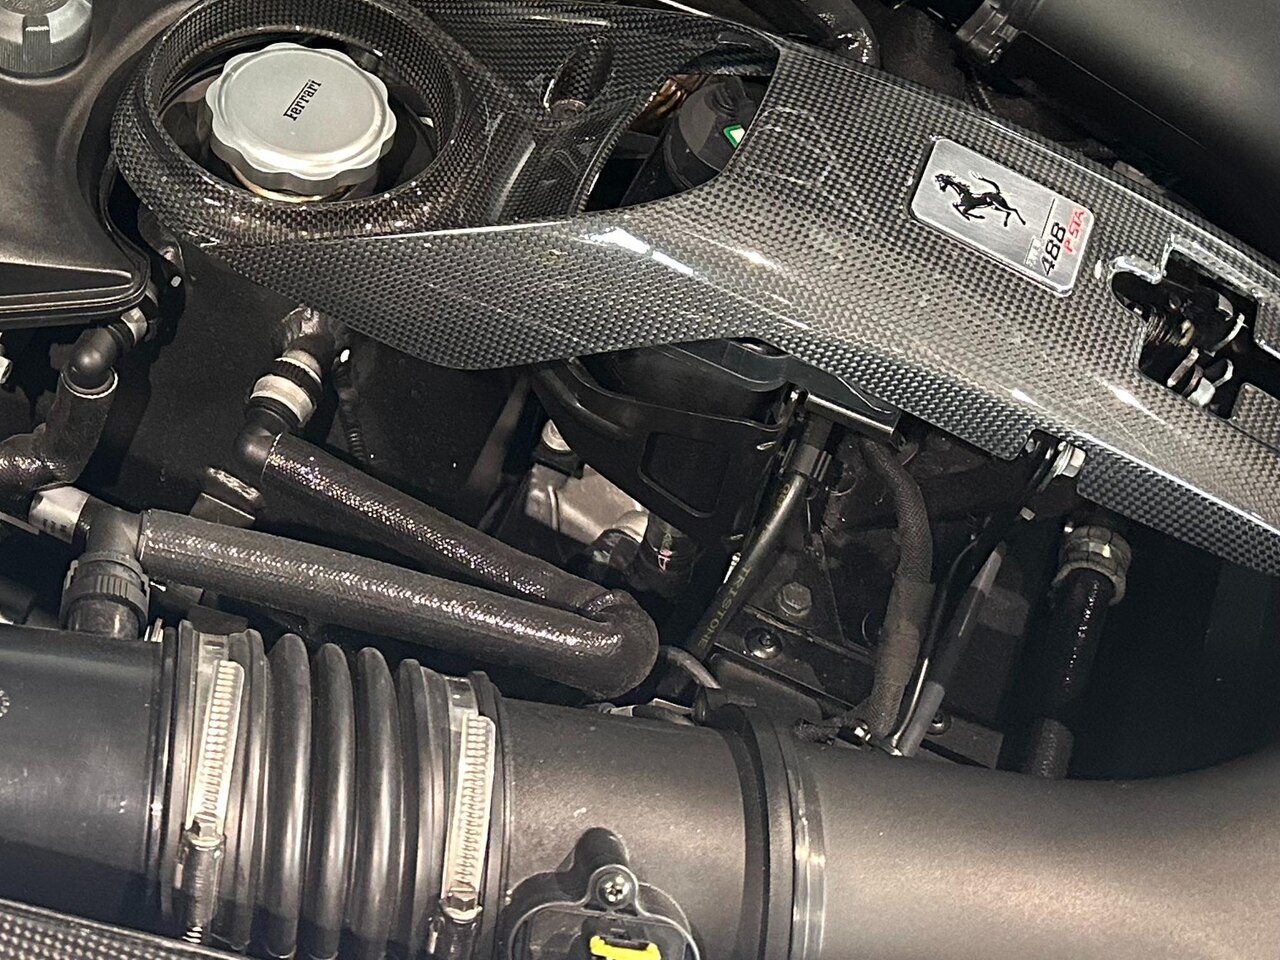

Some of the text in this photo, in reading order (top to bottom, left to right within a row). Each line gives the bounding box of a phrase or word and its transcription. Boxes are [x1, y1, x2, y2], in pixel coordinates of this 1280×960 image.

[282, 79, 322, 121] Ferrari
[1042, 222, 1066, 275] 488
[1064, 210, 1085, 253] PSTA
[697, 566, 752, 649] TRISTONE
